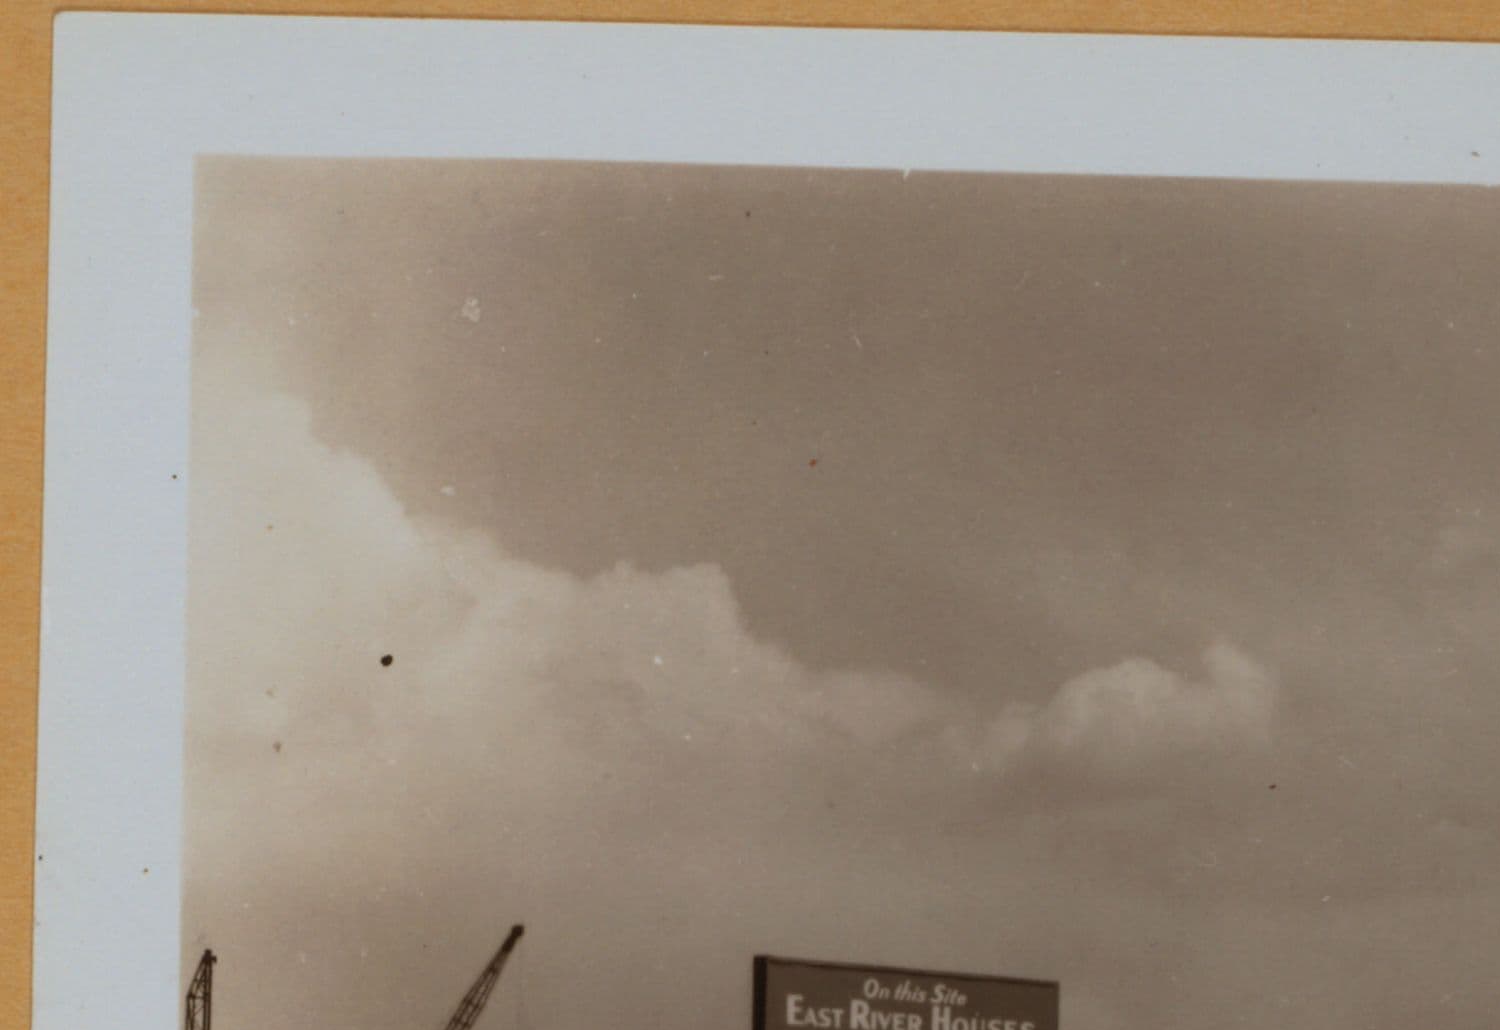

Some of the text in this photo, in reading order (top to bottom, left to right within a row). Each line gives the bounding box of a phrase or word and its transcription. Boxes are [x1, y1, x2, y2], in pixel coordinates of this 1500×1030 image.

[864, 979, 967, 1004] On this Site
[786, 994, 848, 1027] EAST
